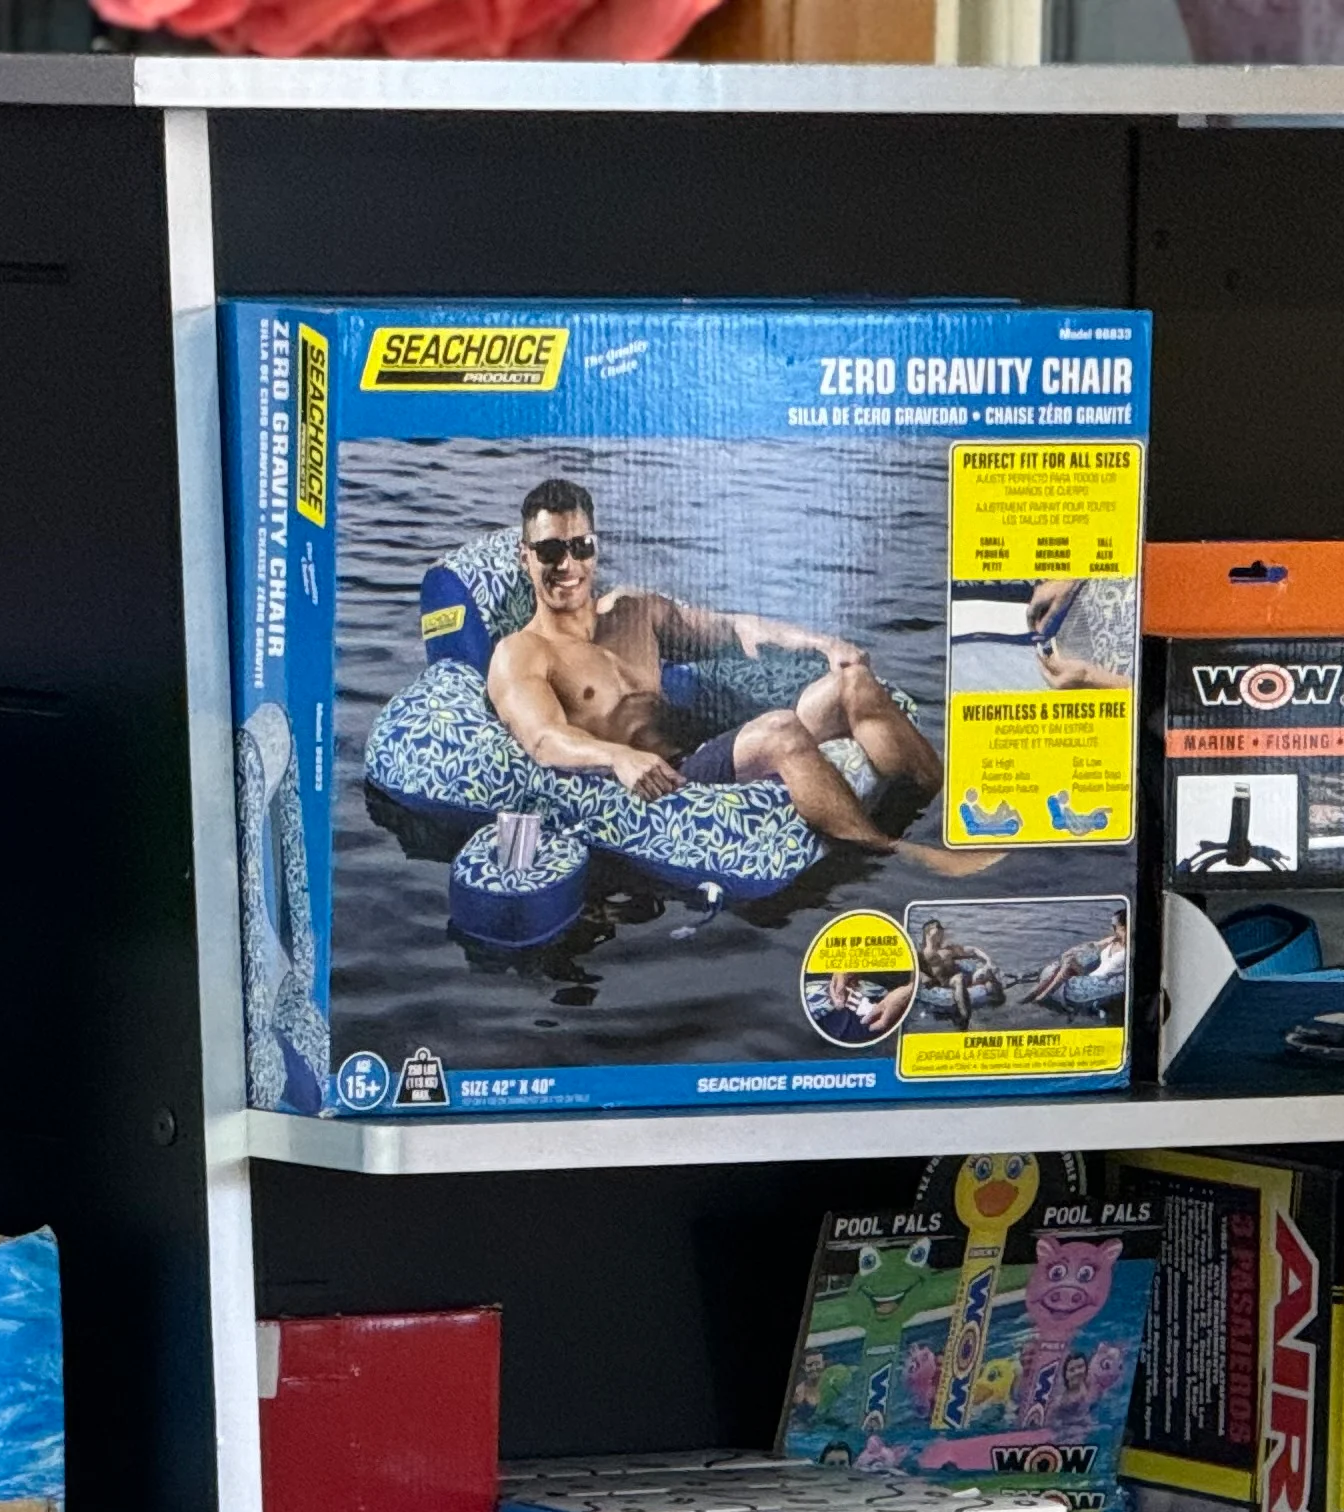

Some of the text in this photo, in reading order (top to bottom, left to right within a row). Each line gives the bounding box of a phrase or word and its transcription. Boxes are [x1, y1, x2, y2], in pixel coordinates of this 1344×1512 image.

[382, 334, 556, 366] SEACHOICE
[820, 357, 1132, 395] ZERO GRAVITY CHAIR
[788, 403, 1132, 425] SILLA DE CERO GRAVEDAD CHAISE ZÉRO GRAVITÉ
[963, 452, 1131, 470] PERFECT FIT FOR ALL SIZES
[268, 321, 290, 658] ZERO GRAVITY CHAIR
[1192, 664, 1343, 710] WOW
[963, 701, 1126, 722] WEIGHTLESS & STRESS FREE
[1184, 733, 1246, 751] MARINE
[1266, 733, 1330, 750] FISHING
[346, 1076, 380, 1099] 15+
[461, 1078, 555, 1097] SIZE 42" X 40"
[698, 1074, 877, 1092] SEACHOICE PRODUCTS
[834, 1212, 942, 1239] POOL PALS
[1043, 1202, 1151, 1227] POOL PALS
